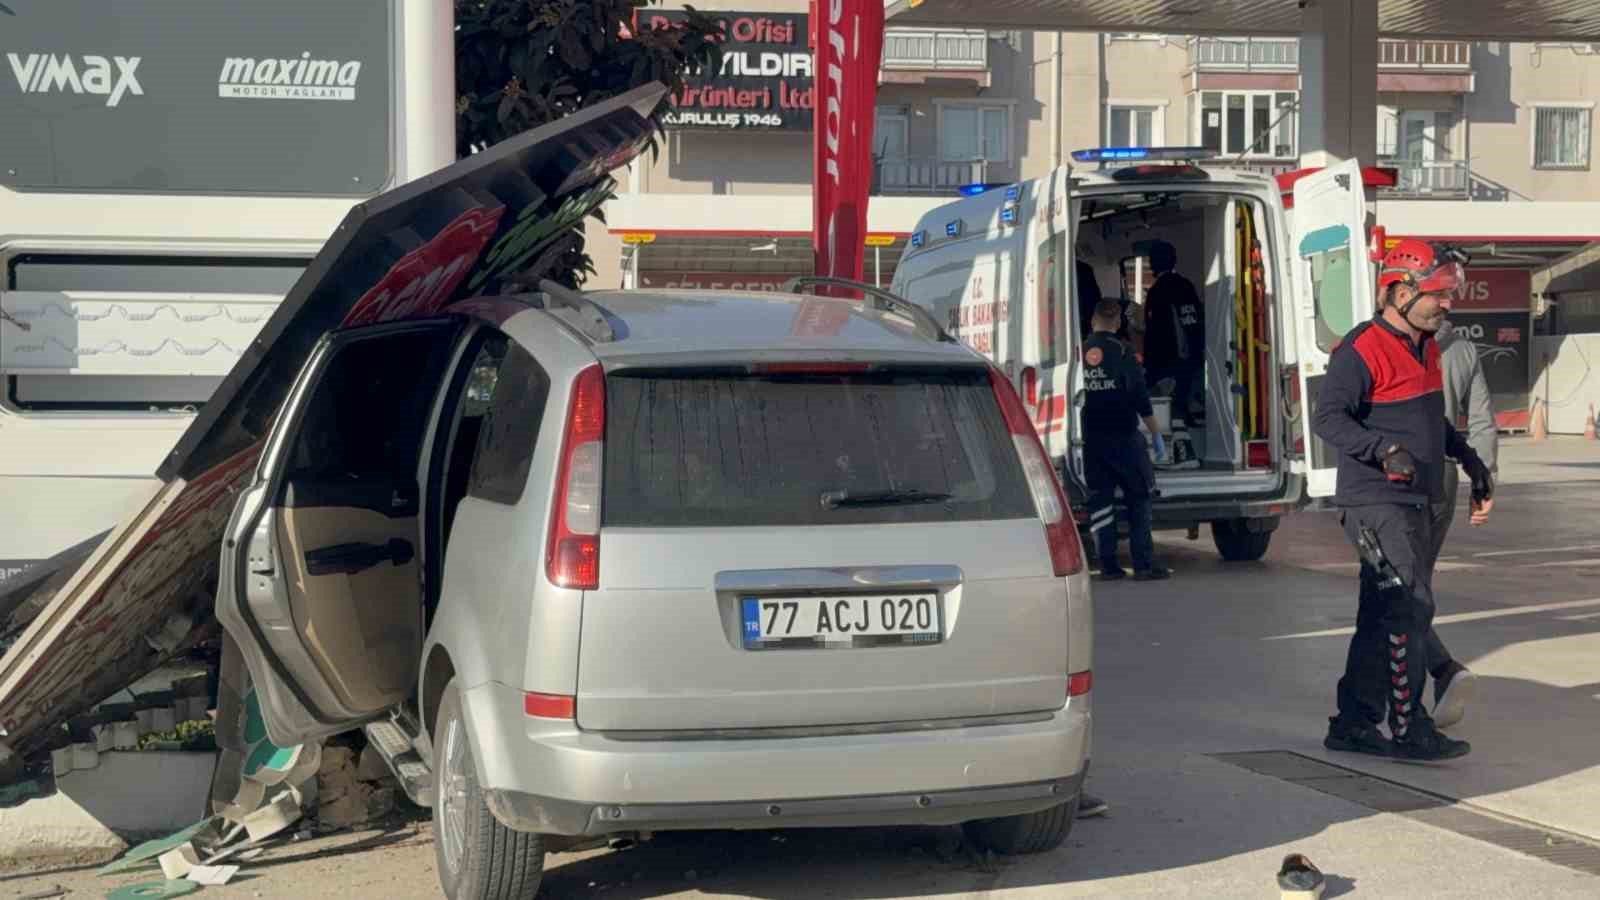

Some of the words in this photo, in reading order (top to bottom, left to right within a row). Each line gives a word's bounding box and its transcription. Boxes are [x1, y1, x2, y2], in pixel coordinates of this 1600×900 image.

[732, 16, 793, 42] Ofisi
[219, 51, 361, 85] maxima
[719, 51, 814, 76] YILDIR
[232, 86, 277, 97] MOTOR
[743, 112, 782, 126] 1946
[1083, 380, 1117, 391] AĞLIK
[763, 602, 799, 635] 77
[816, 599, 869, 633] ACJ
[880, 598, 931, 631] 020
[745, 621, 760, 632] TR
